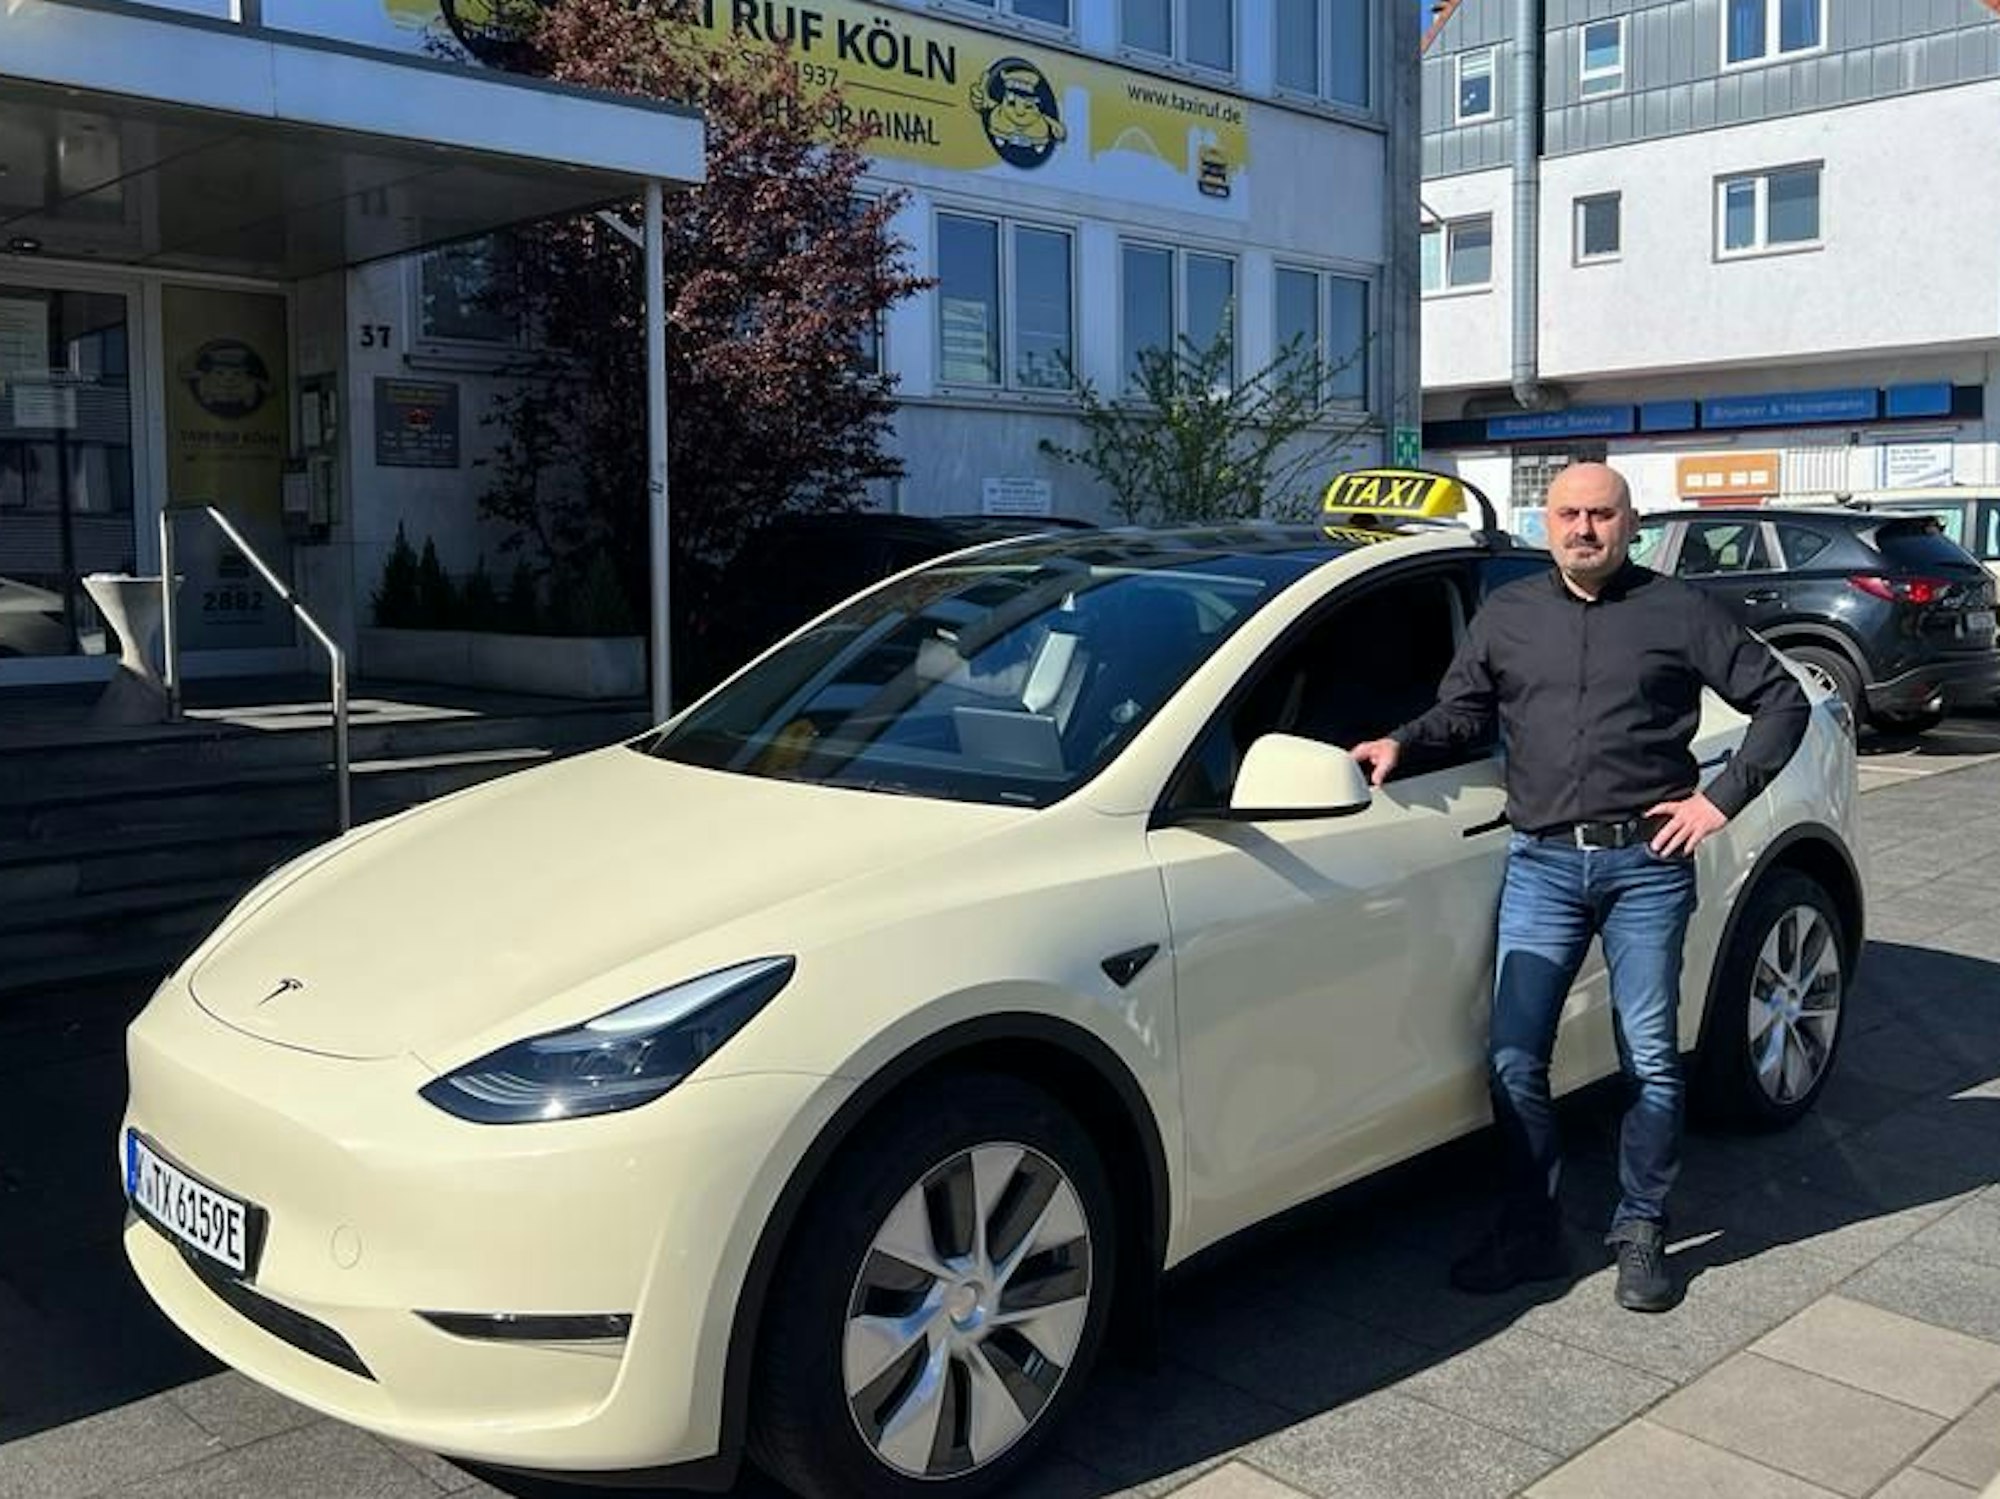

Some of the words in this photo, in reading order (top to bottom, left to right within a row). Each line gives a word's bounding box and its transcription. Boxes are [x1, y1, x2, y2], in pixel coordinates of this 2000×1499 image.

[732, 0, 823, 50] RUF
[838, 17, 956, 84] KÖLN
[1127, 83, 1242, 124] www.taxiruf.de
[361, 325, 390, 348] 37
[1342, 476, 1427, 508] TAXI
[153, 1162, 172, 1221] TX
[177, 1183, 240, 1260] 6159E
